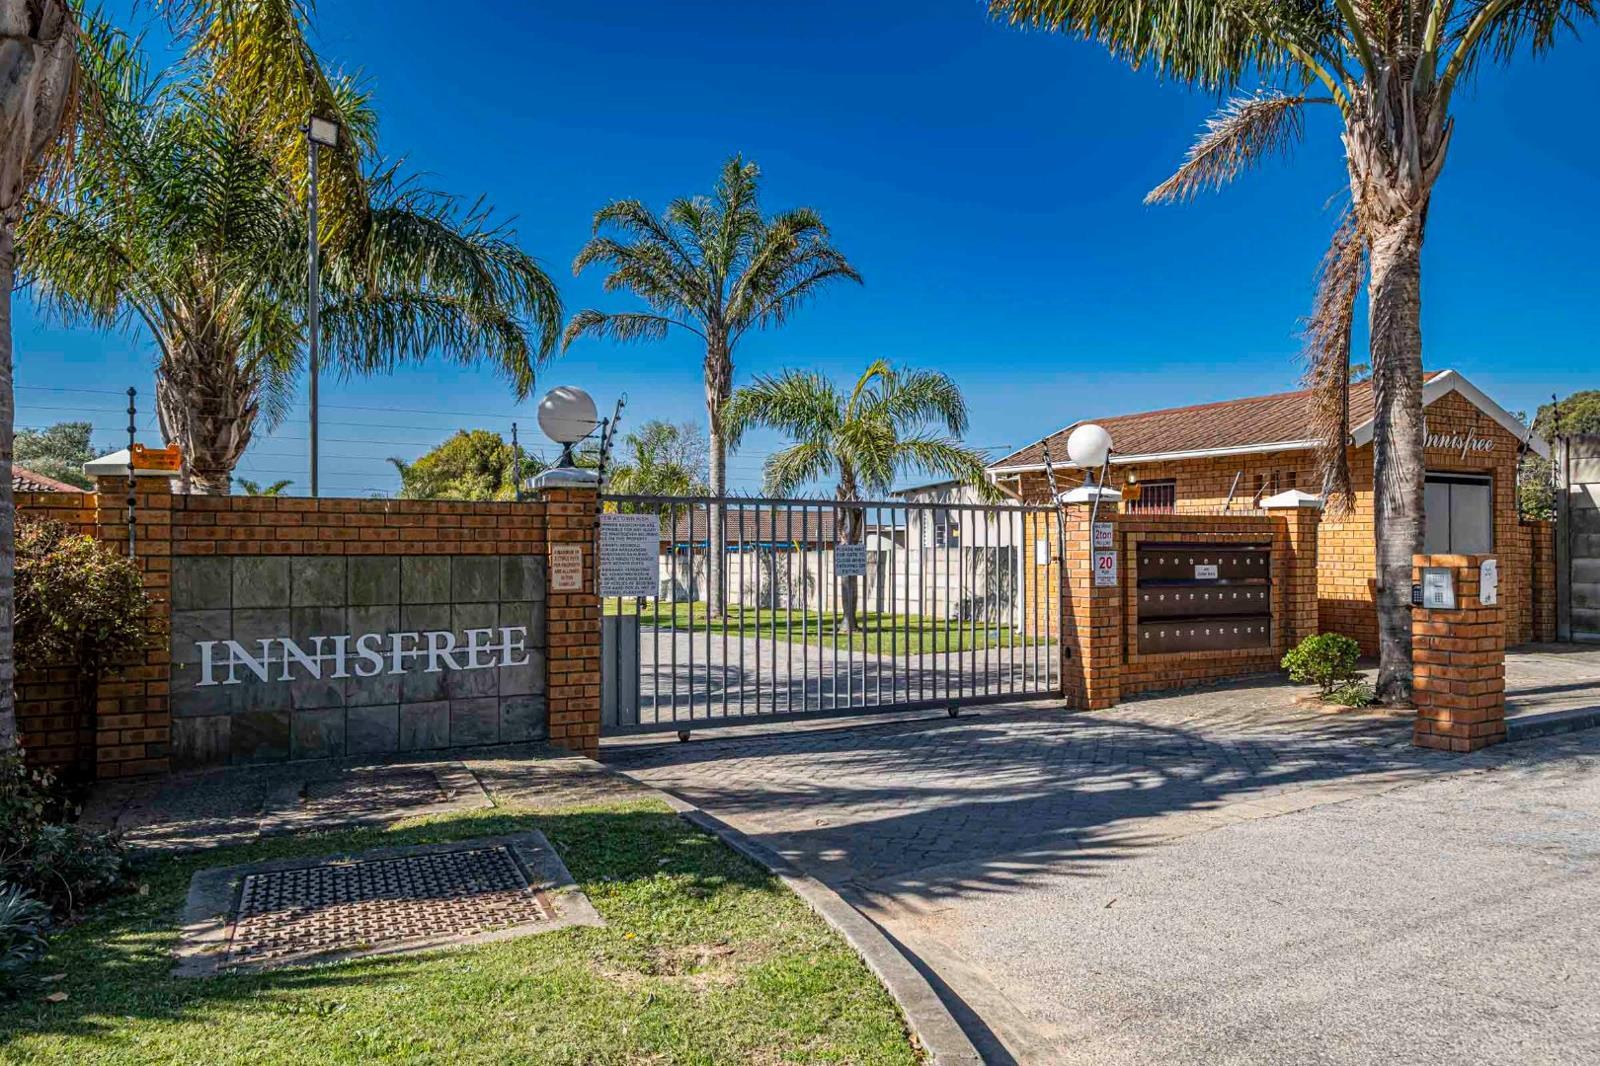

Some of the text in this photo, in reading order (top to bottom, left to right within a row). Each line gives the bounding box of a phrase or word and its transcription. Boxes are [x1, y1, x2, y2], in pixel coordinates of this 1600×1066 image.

[1095, 530, 1112, 540] 2ton
[1099, 556, 1113, 569] 20
[194, 626, 531, 687] INNISFREE
